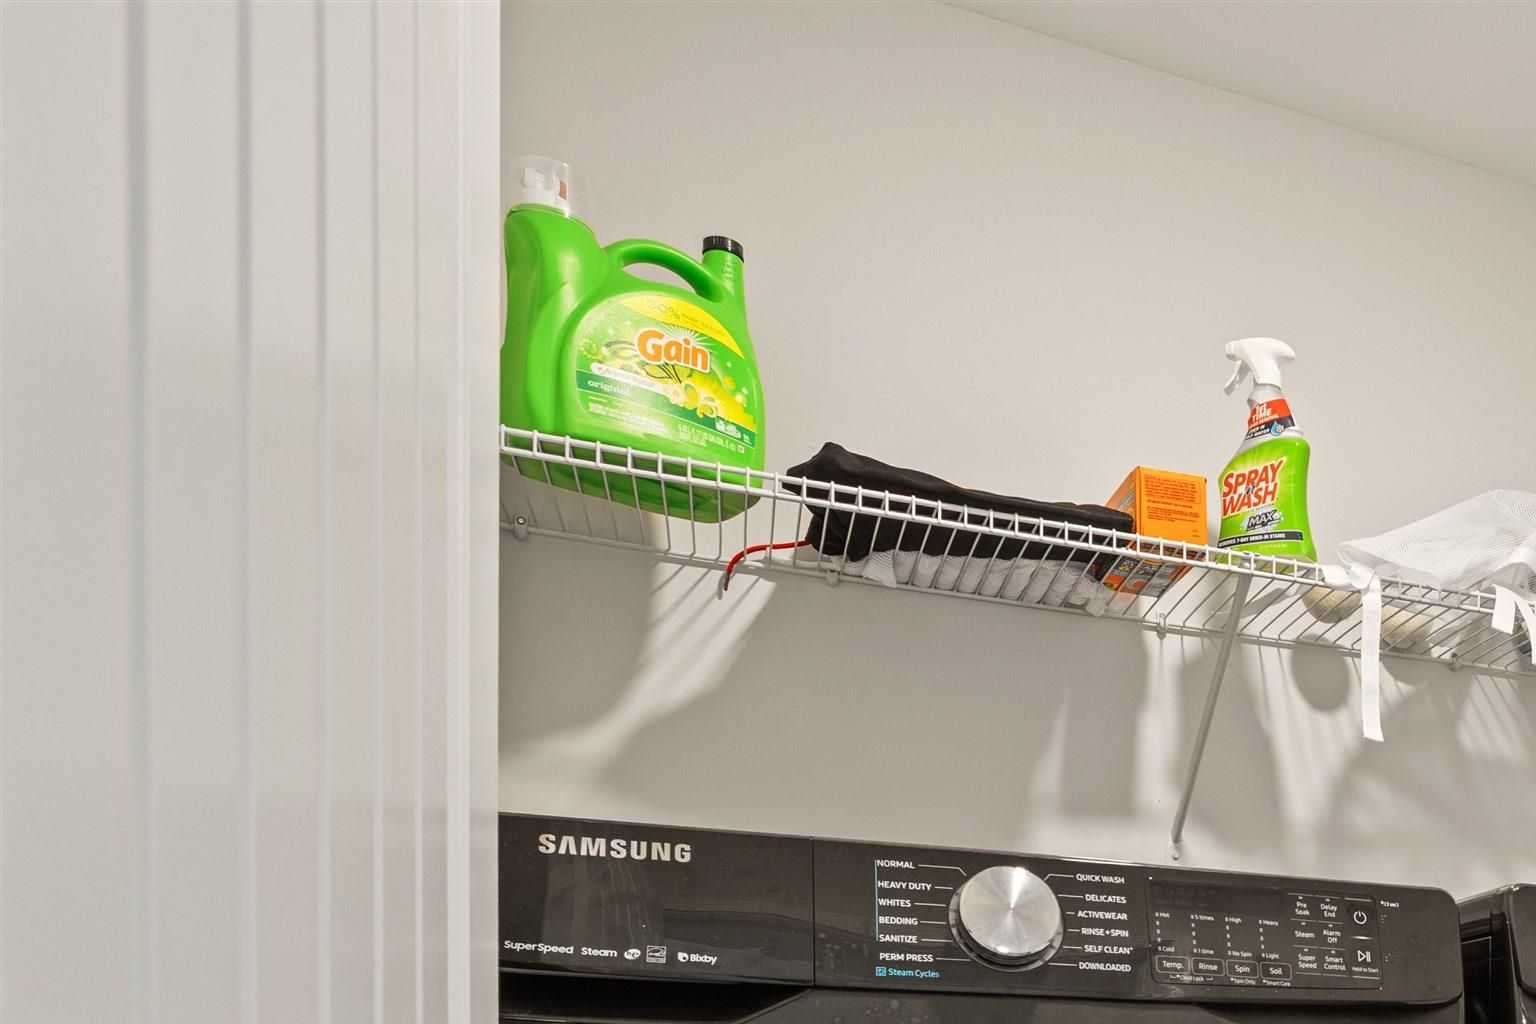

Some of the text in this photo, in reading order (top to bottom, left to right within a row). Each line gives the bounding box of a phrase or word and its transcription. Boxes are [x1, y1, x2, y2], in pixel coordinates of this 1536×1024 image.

[636, 328, 711, 372] Gain
[1222, 458, 1285, 498] SPRAY
[1222, 481, 1279, 517] WASH
[1247, 509, 1278, 528] MAX
[538, 833, 692, 863] SAMSUNG
[877, 859, 915, 870] NORMAL
[1076, 873, 1125, 885] QUICK WASH
[877, 881, 932, 892] HEAVY DUTY
[878, 898, 911, 908] WHITES
[1085, 894, 1127, 904] DELICATES
[1077, 910, 1129, 921] ACTIVEWEAR
[878, 916, 919, 926] BEDDING
[878, 934, 919, 944] SANITIZE
[1294, 930, 1315, 939] Steam
[581, 946, 618, 958] Steam
[1083, 944, 1103, 953] SELF
[690, 954, 718, 965] Bixby
[879, 952, 934, 962] PERM PRESS
[1078, 962, 1132, 972] DOWNLOADED
[1163, 961, 1184, 969] Temp.
[1198, 962, 1218, 971] Rinse
[1234, 965, 1251, 973] Spin
[1323, 963, 1346, 971] Control
[888, 968, 940, 979] Steam Cycles
[1269, 967, 1283, 975] Soil
